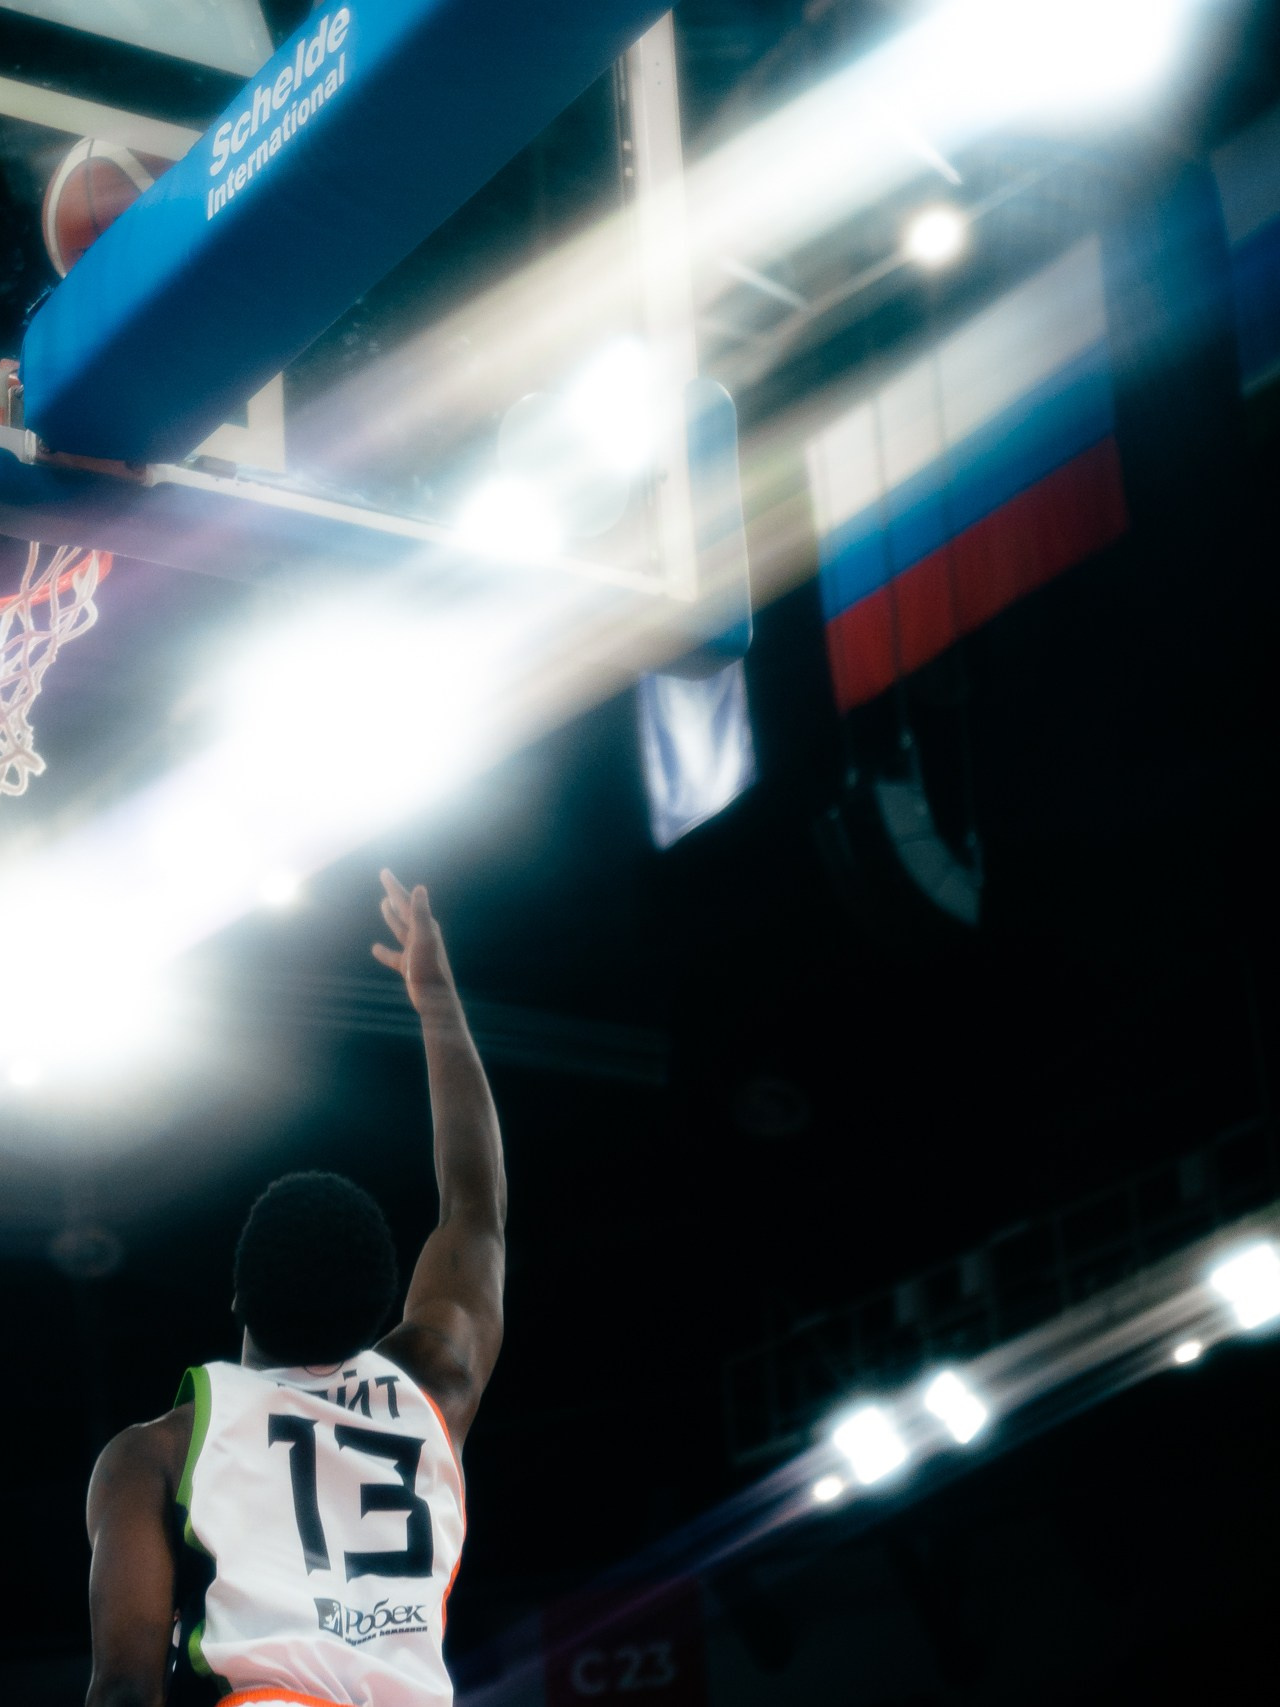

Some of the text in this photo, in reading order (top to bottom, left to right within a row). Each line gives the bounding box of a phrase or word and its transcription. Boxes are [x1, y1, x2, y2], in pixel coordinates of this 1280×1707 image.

[206, 53, 346, 221] International
[210, 8, 350, 176] Schelde
[268, 1413, 435, 1584] 13
[344, 1598, 428, 1636] Робек
